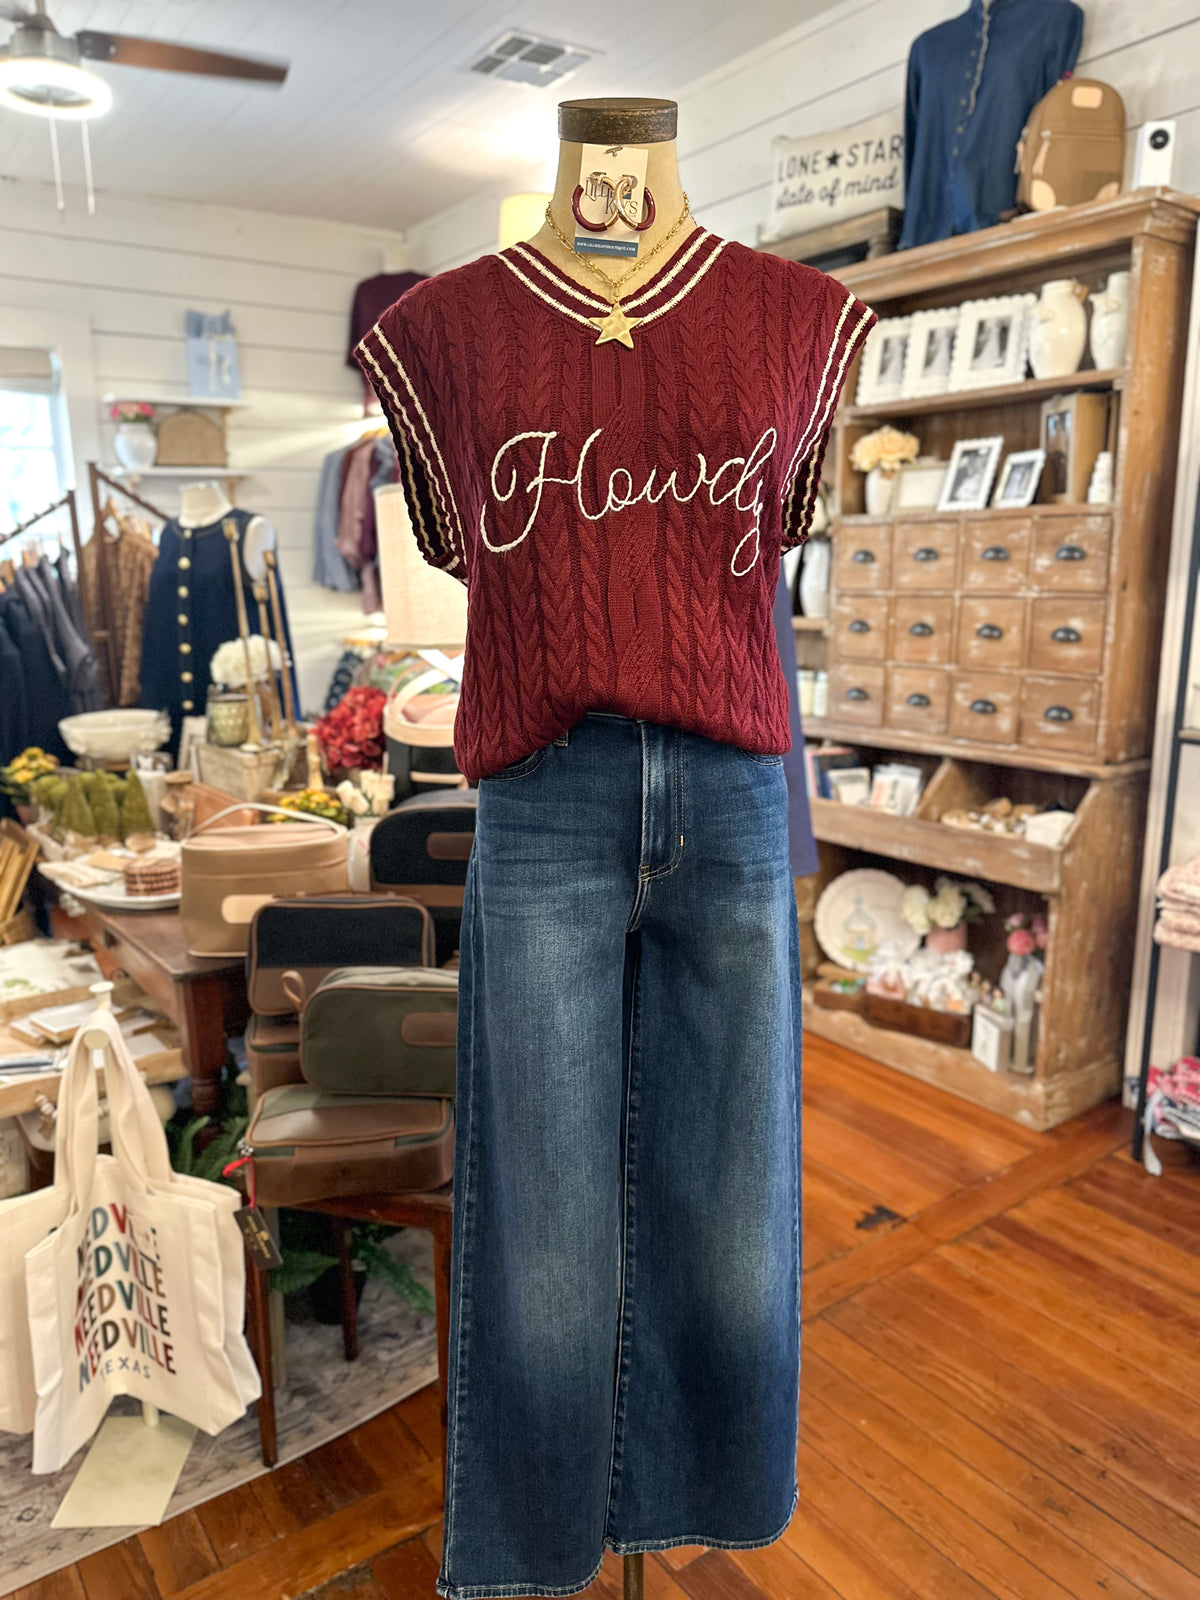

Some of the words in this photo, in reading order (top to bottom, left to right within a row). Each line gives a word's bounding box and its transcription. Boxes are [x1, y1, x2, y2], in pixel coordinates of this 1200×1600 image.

[777, 150, 822, 182] LONE
[845, 134, 903, 168] STAR
[818, 177, 839, 207] of
[844, 166, 899, 197] mind
[480, 427, 778, 577] Howdy
